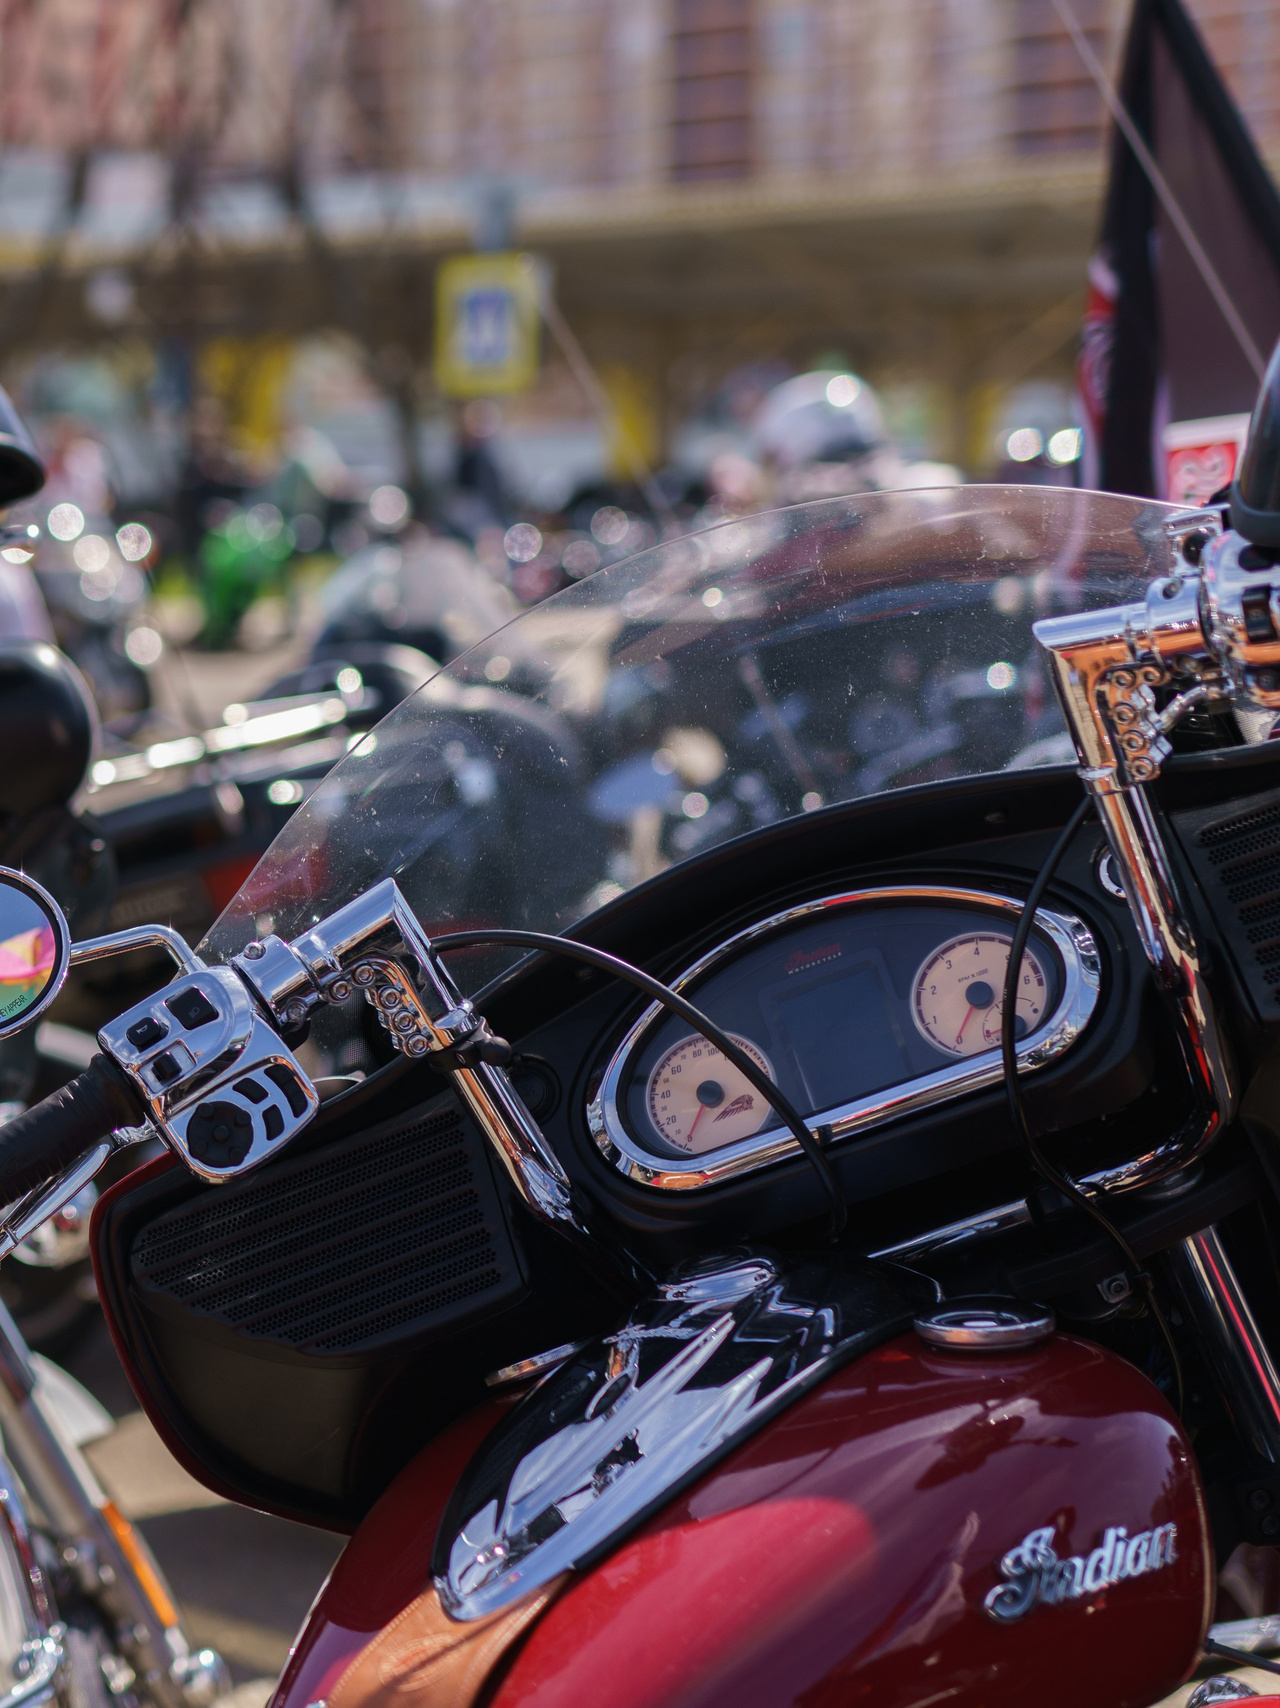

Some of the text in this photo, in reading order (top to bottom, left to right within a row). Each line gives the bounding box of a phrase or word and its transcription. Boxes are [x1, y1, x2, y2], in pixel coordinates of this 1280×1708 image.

[974, 947, 980, 956] 4
[788, 952, 842, 975] MOTORCYCLE
[945, 960, 953, 970] 3
[958, 974, 970, 983] RPM
[976, 968, 989, 977] 1000
[1023, 975, 1031, 985] 6
[930, 985, 937, 995] 2
[8, 994, 28, 1013] APPEAR
[932, 1015, 937, 1025] 1
[956, 1034, 963, 1045] 0
[692, 1048, 702, 1058] 80
[707, 1047, 720, 1057] 100
[671, 1064, 682, 1075] 60
[661, 1089, 671, 1100] 40
[661, 1105, 668, 1113] 30
[666, 1115, 677, 1126] 20
[687, 1134, 693, 1143] 0
[984, 1521, 1179, 1622] Indian
